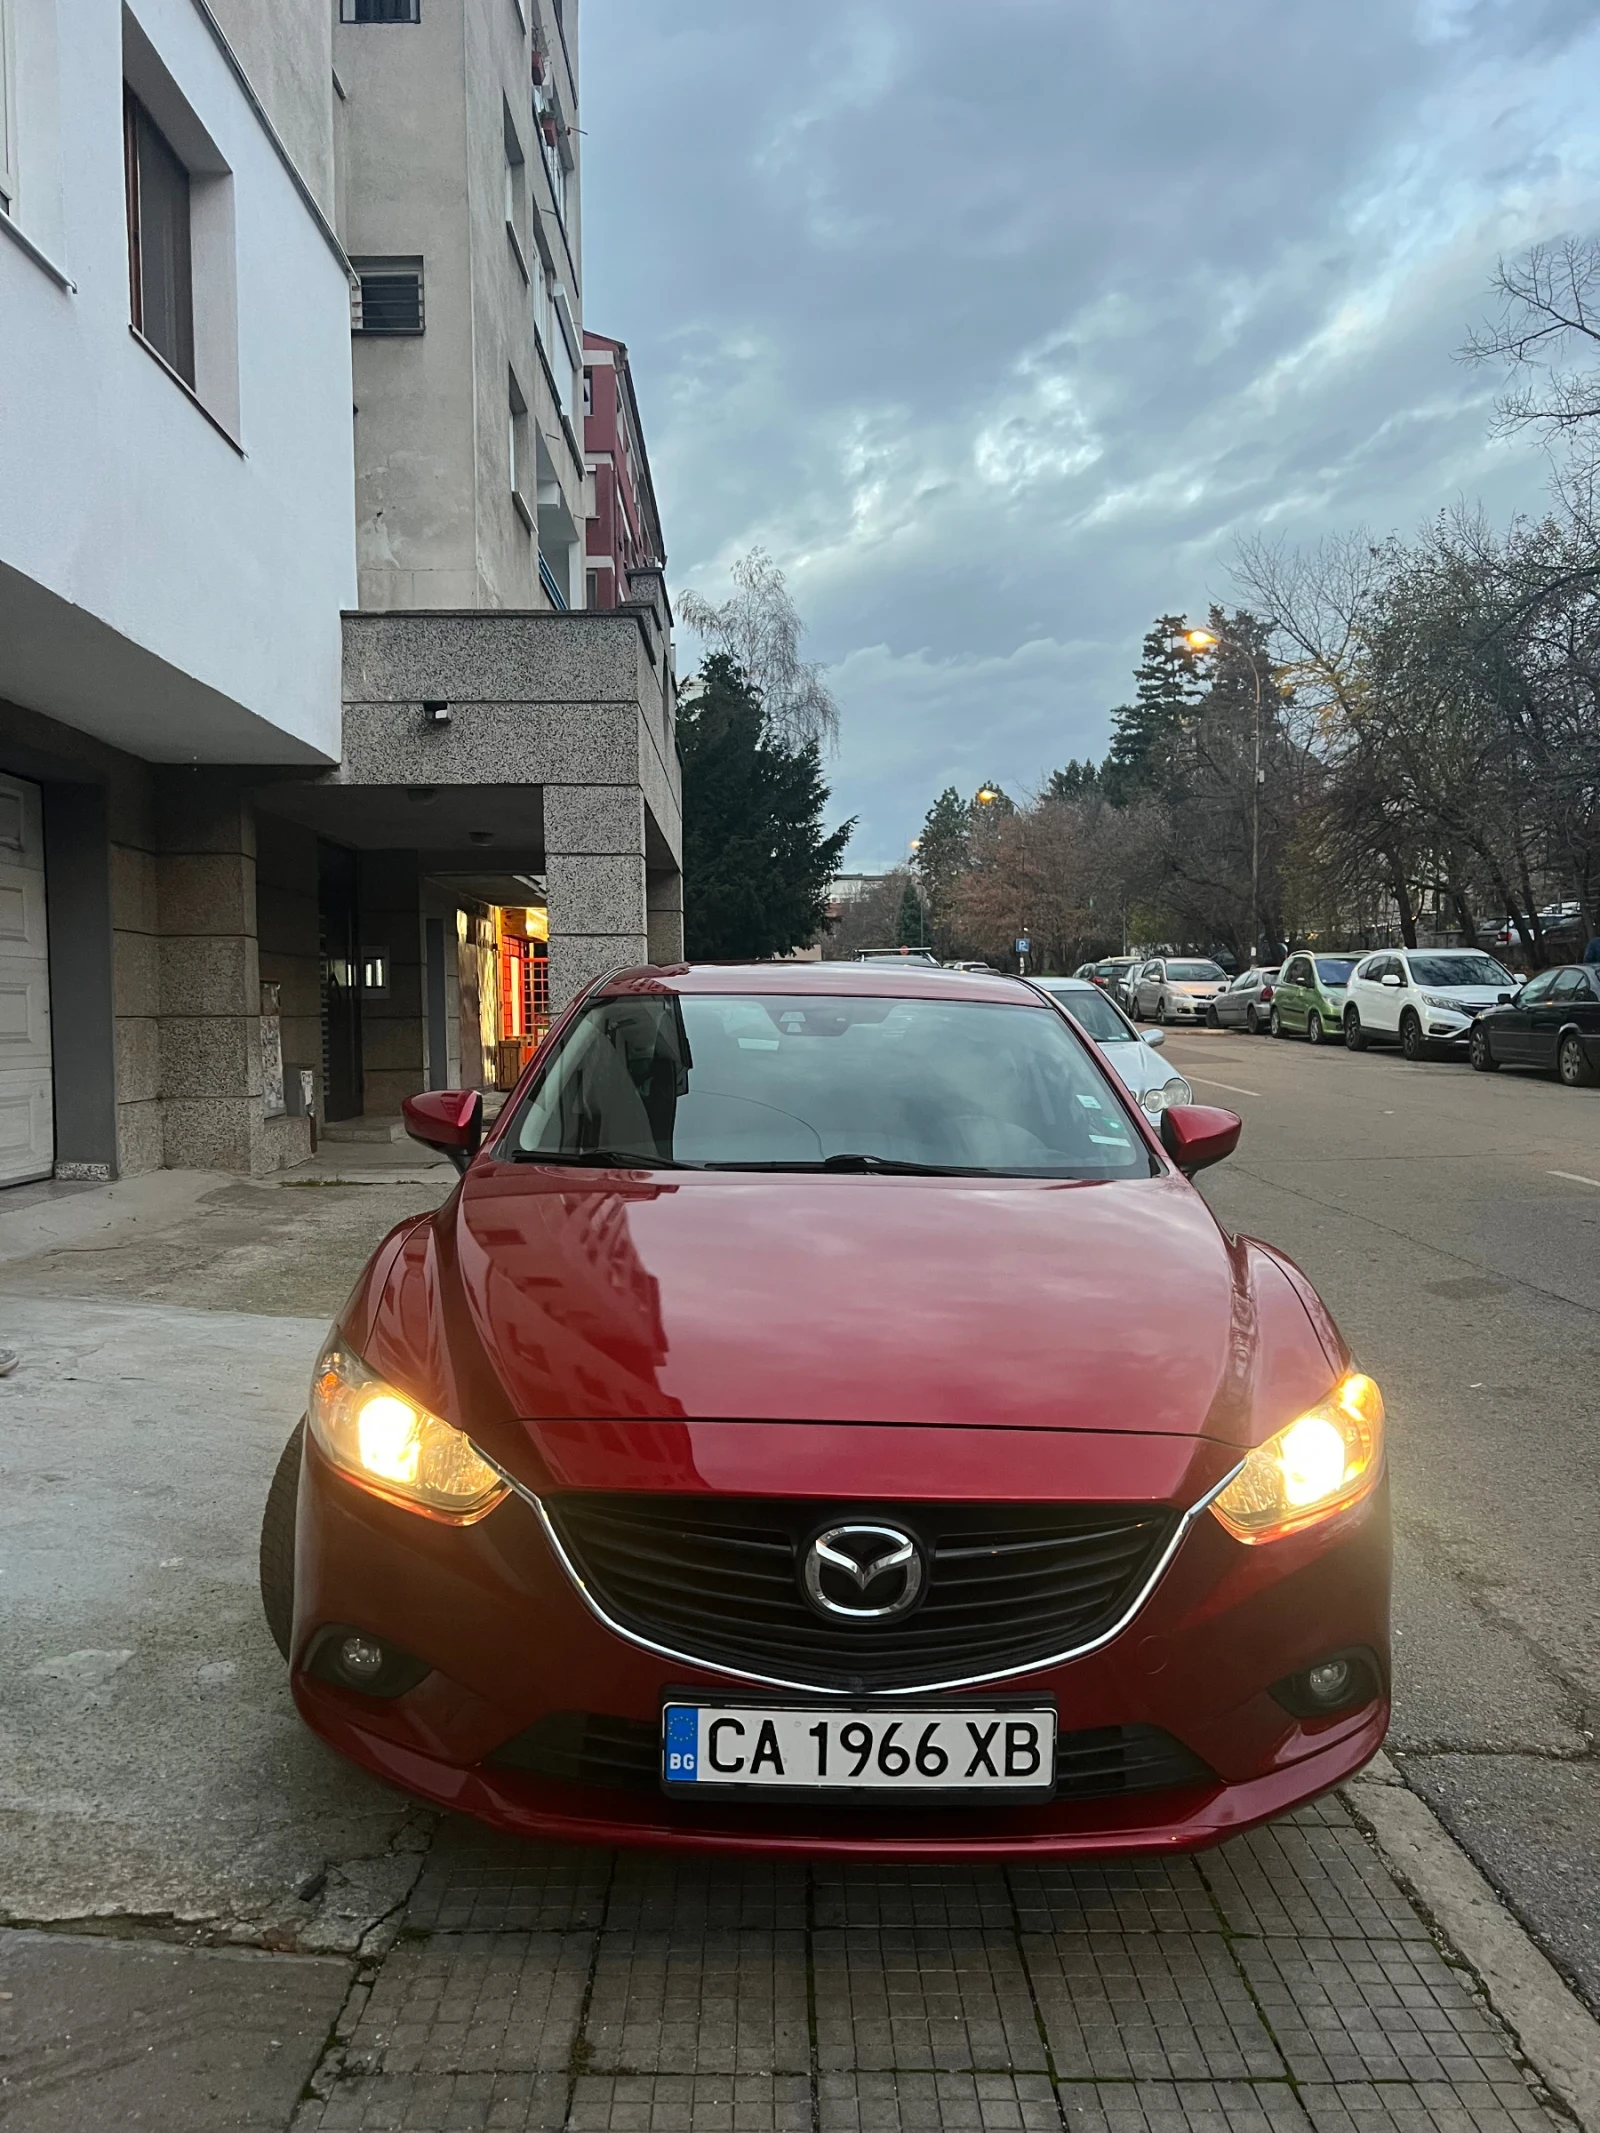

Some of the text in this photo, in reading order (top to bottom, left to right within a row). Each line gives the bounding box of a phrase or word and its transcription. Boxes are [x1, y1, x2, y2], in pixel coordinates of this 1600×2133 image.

[669, 1753, 695, 1770] BG
[708, 1718, 1041, 1777] CA 1966 XB
